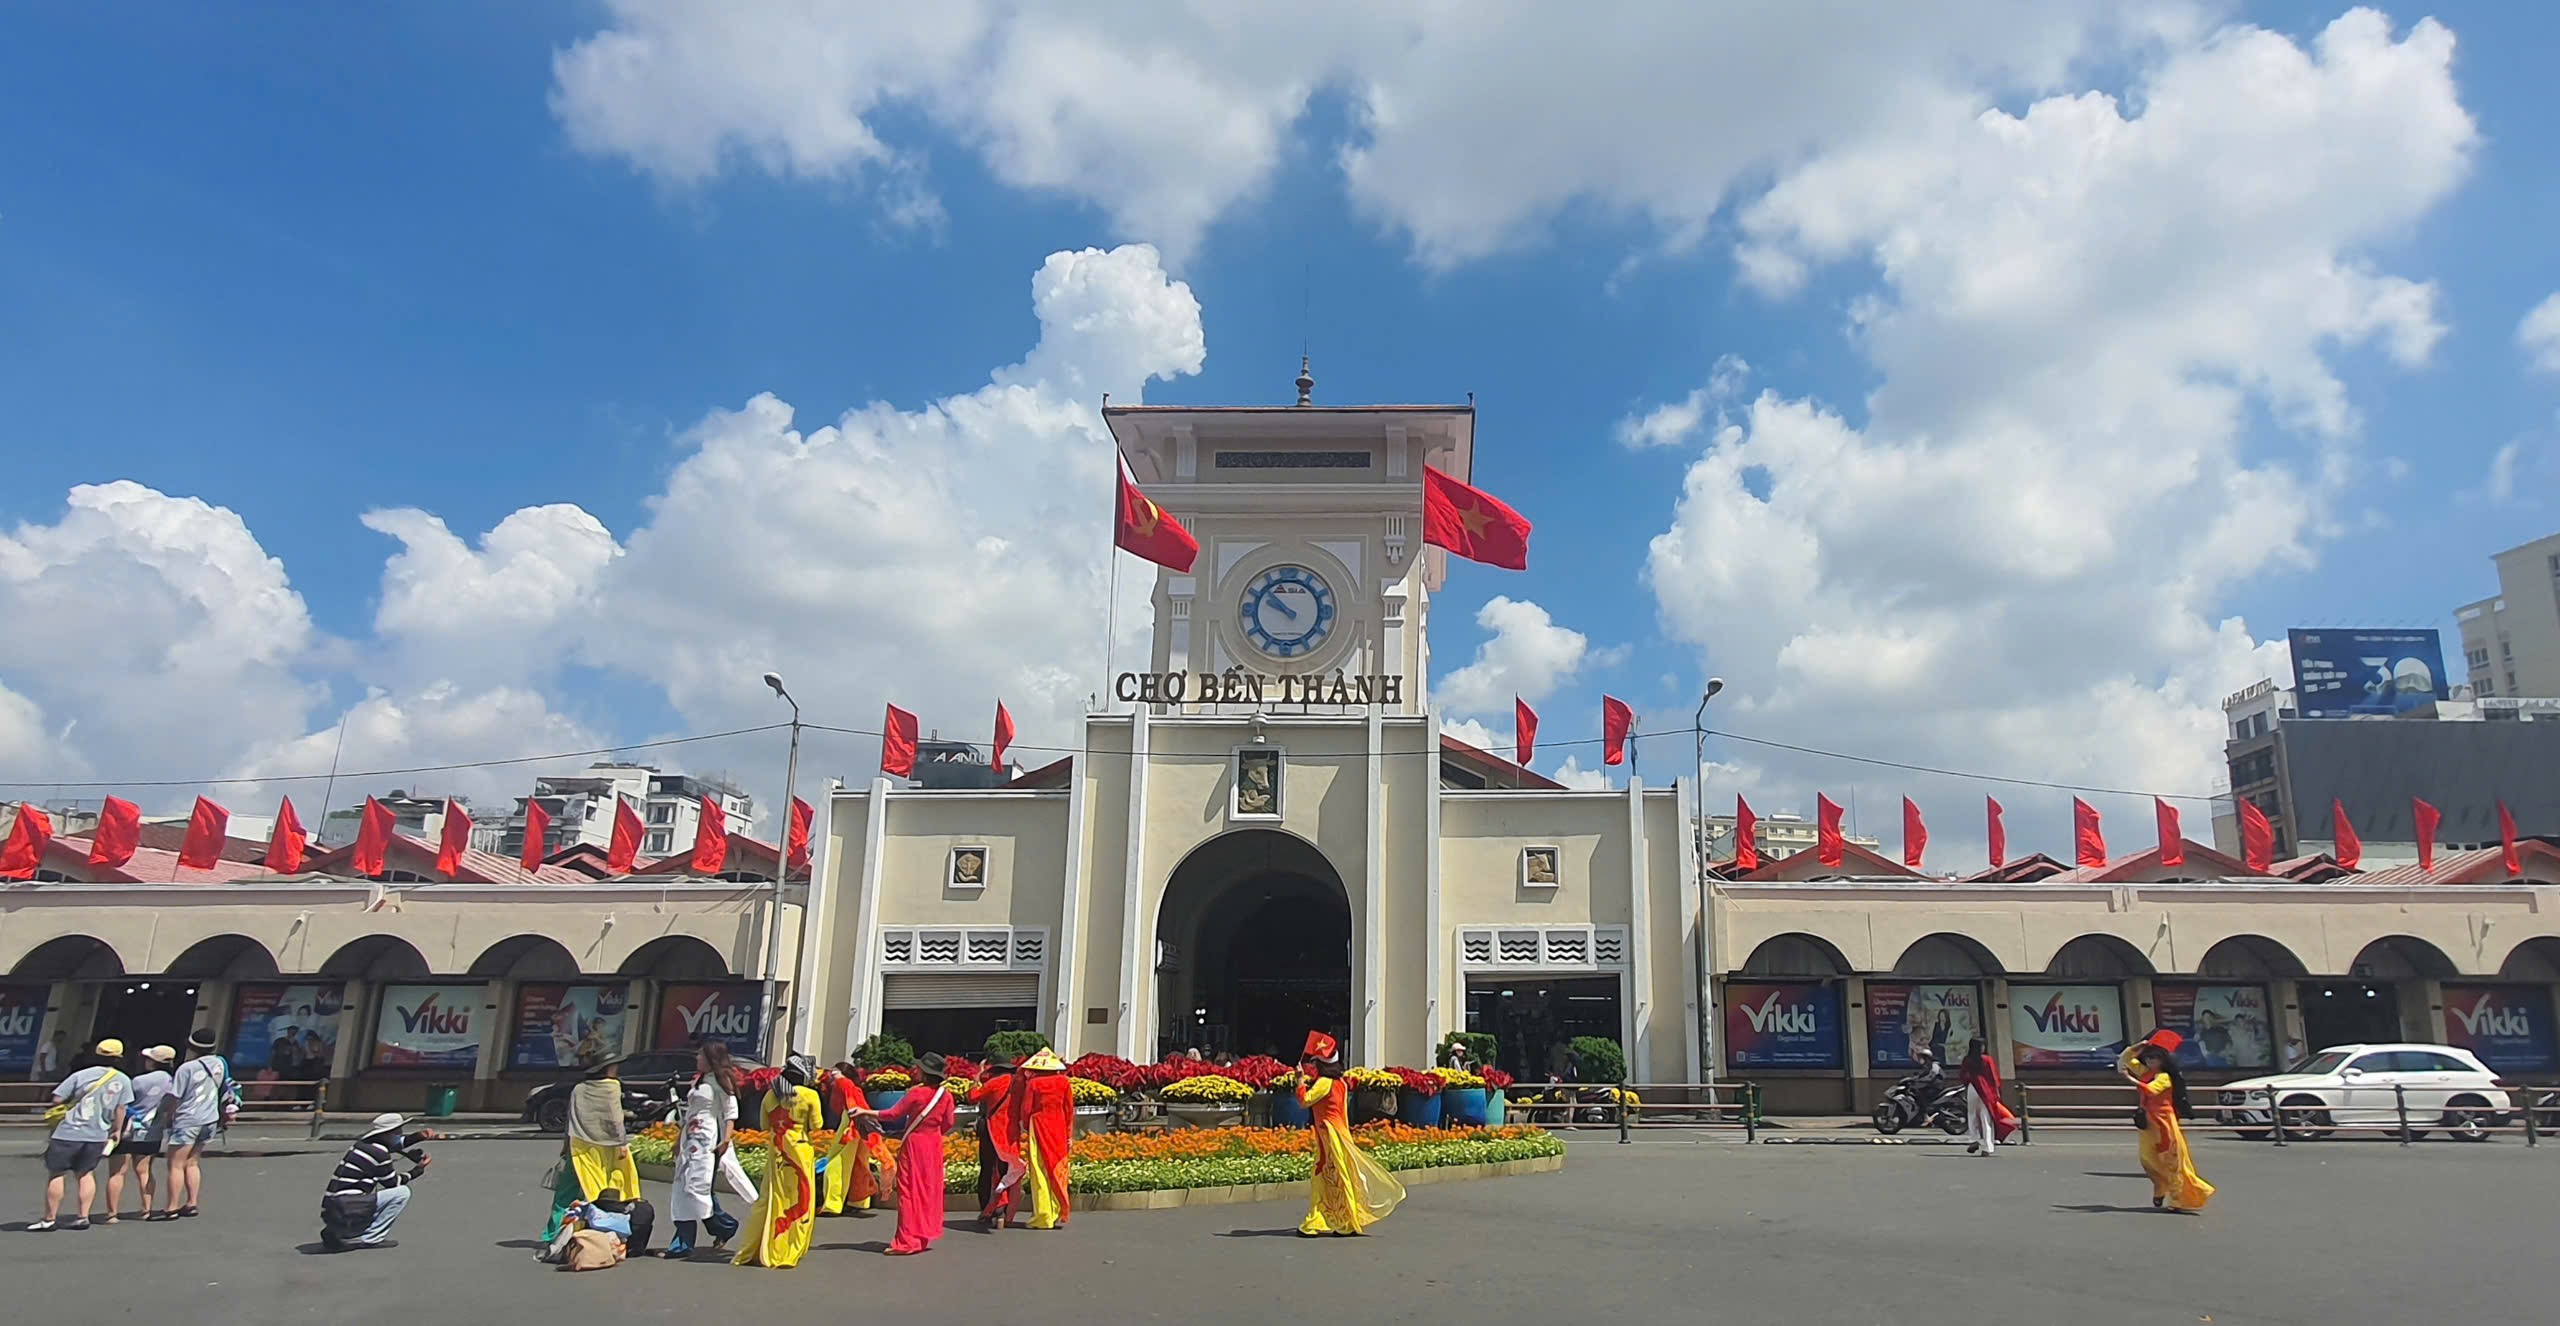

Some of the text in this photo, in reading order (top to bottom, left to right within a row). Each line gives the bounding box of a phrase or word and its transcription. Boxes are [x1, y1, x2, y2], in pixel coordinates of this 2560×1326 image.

[1115, 664, 1403, 706] CHỢ BẾN THÀNH
[396, 991, 471, 1034] Vikki
[676, 991, 751, 1034] Vikki
[1740, 990, 1816, 1033] Vikki
[1936, 988, 1970, 1007] Vikki
[2023, 990, 2100, 1033] Vikki
[2451, 993, 2529, 1036] Vikki
